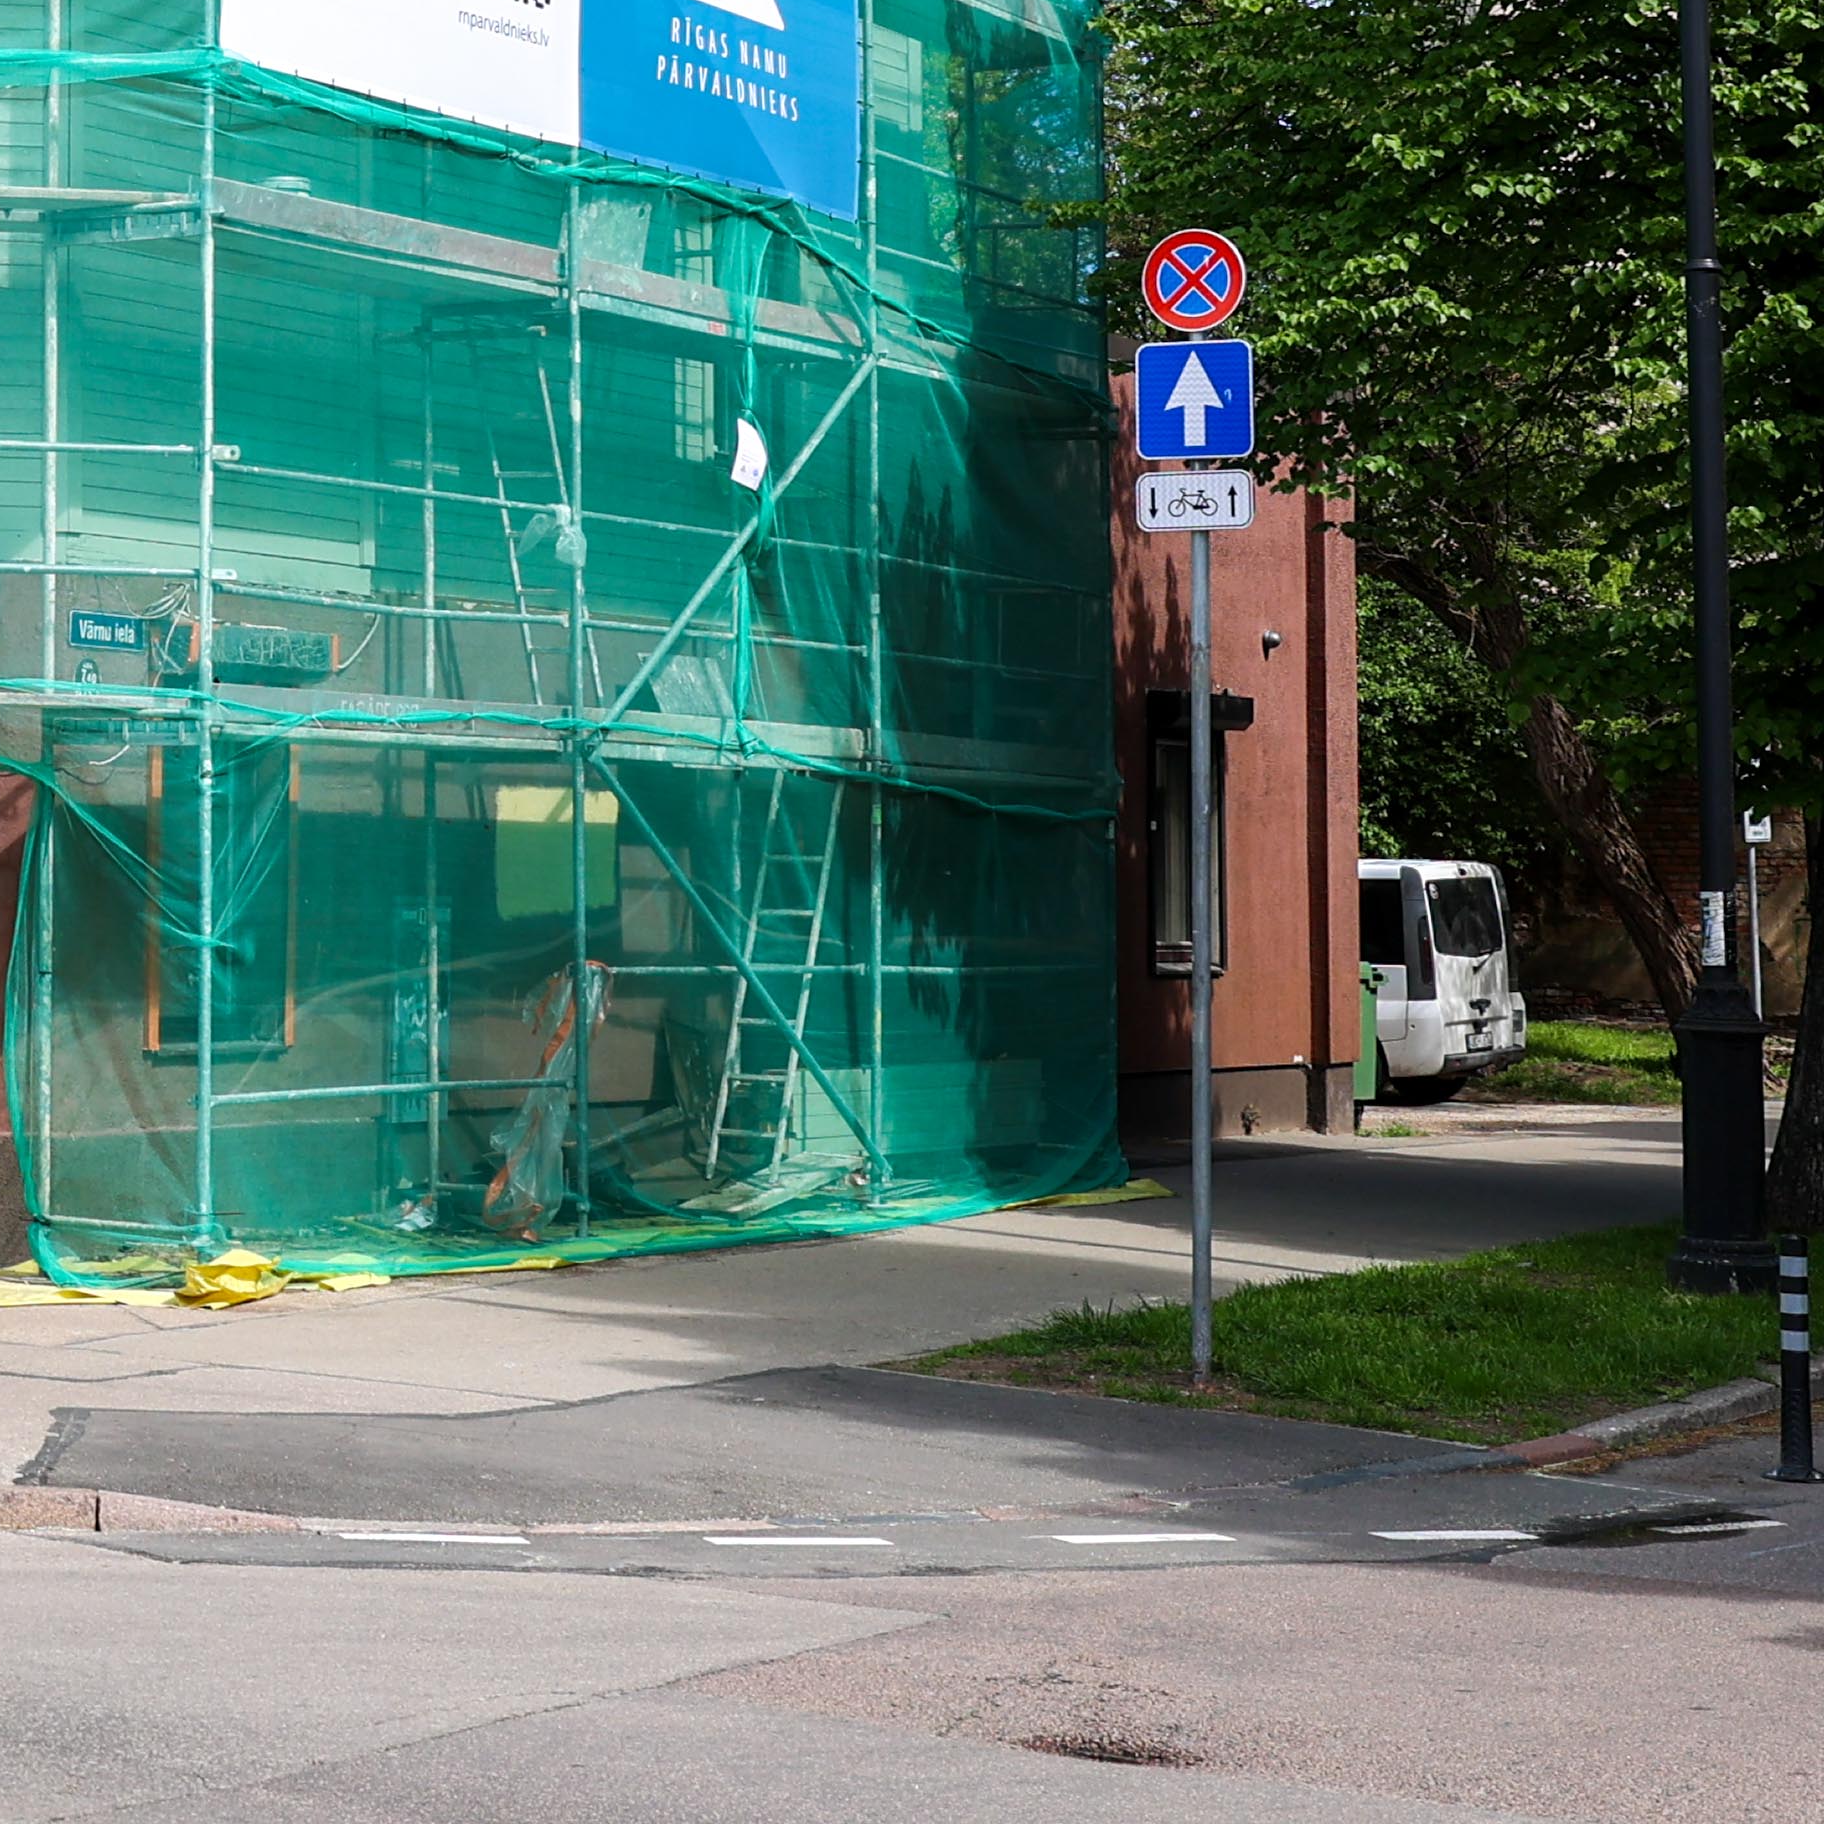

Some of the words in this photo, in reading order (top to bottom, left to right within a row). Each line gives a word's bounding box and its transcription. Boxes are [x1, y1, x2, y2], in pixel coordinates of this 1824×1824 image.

[458, 8, 551, 48] rnparvaldnieks.lv
[670, 16, 730, 58] RĪGAS
[739, 39, 789, 79] NAMU
[657, 54, 800, 122] PĀRVALDNIEKS
[79, 619, 112, 642] Vārnu
[114, 623, 135, 644] iela
